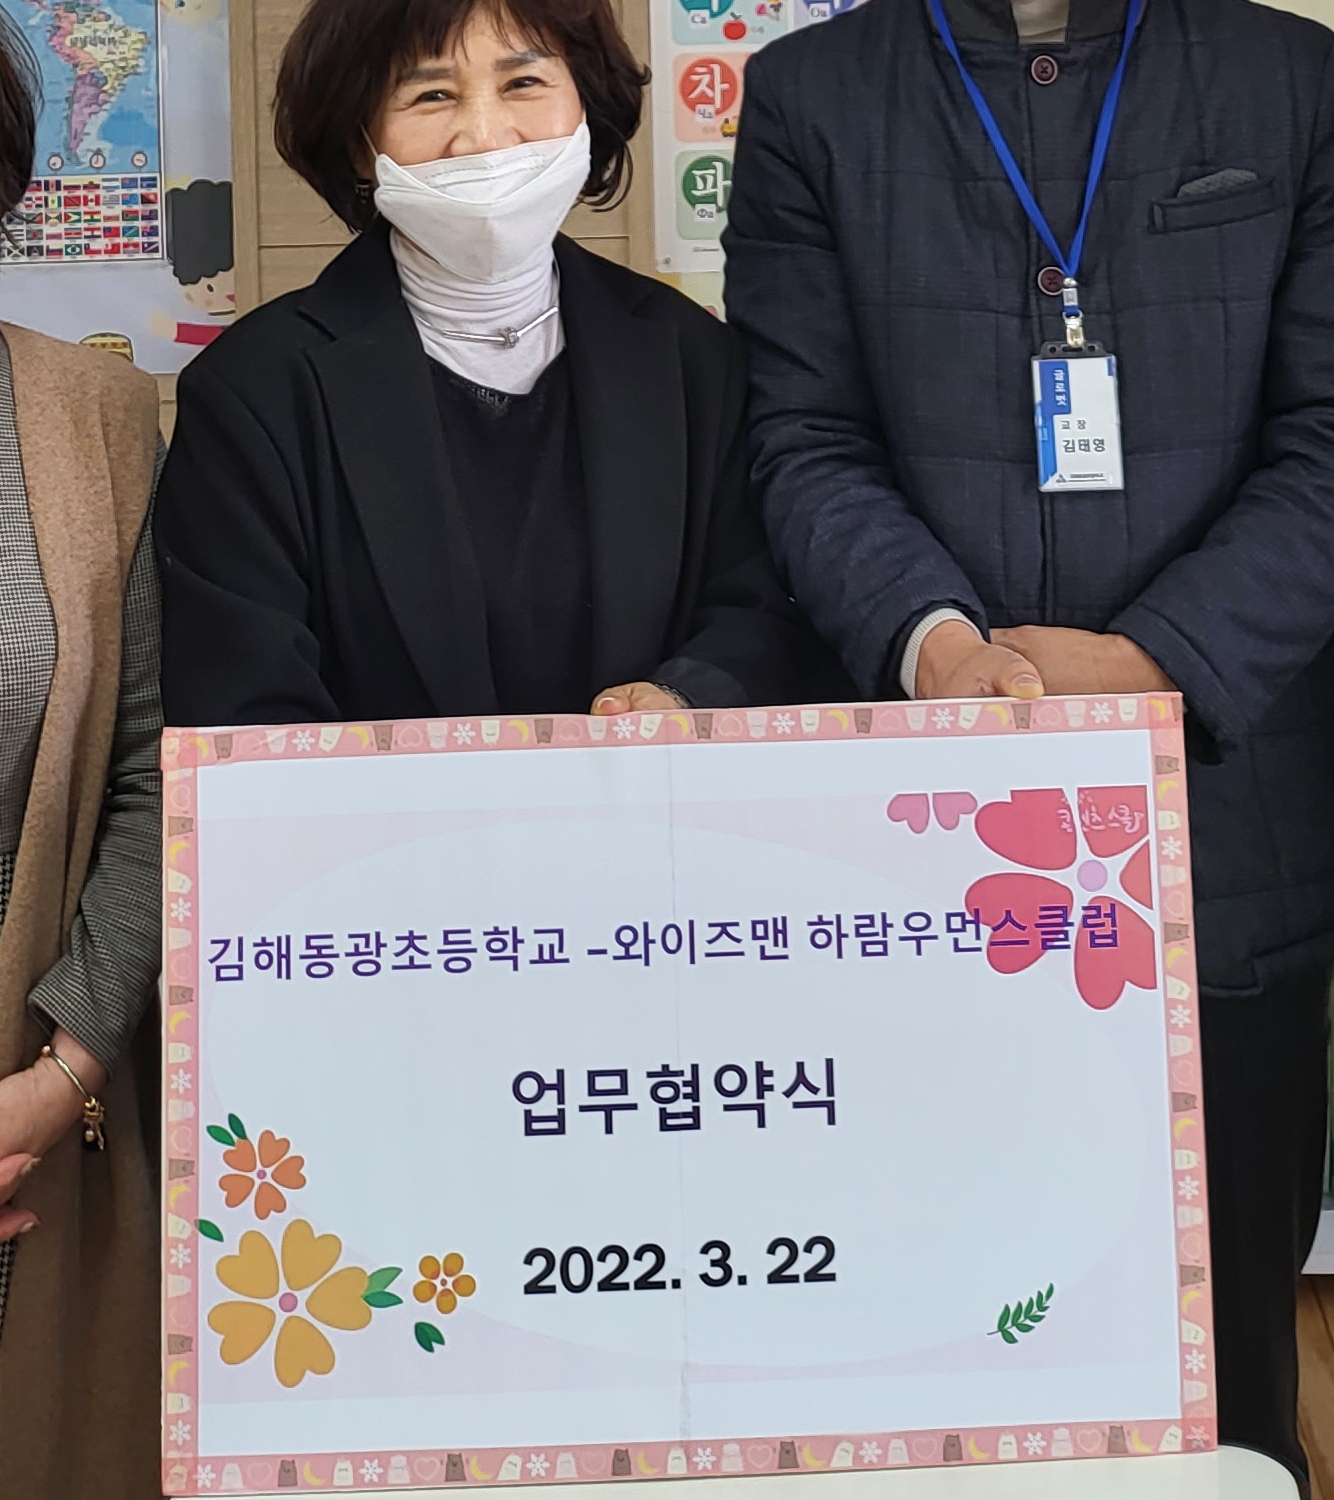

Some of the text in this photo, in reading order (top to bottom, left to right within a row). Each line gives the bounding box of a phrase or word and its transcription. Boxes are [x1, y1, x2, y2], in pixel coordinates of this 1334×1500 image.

[688, 63, 730, 109] 차
[691, 161, 732, 208] 파
[206, 902, 1119, 982] 김해동광초등학교 -와이즈맨 하람우먼스클럽
[511, 1057, 837, 1137] 업무협약식
[522, 1235, 837, 1296] 2022. 3. 22
